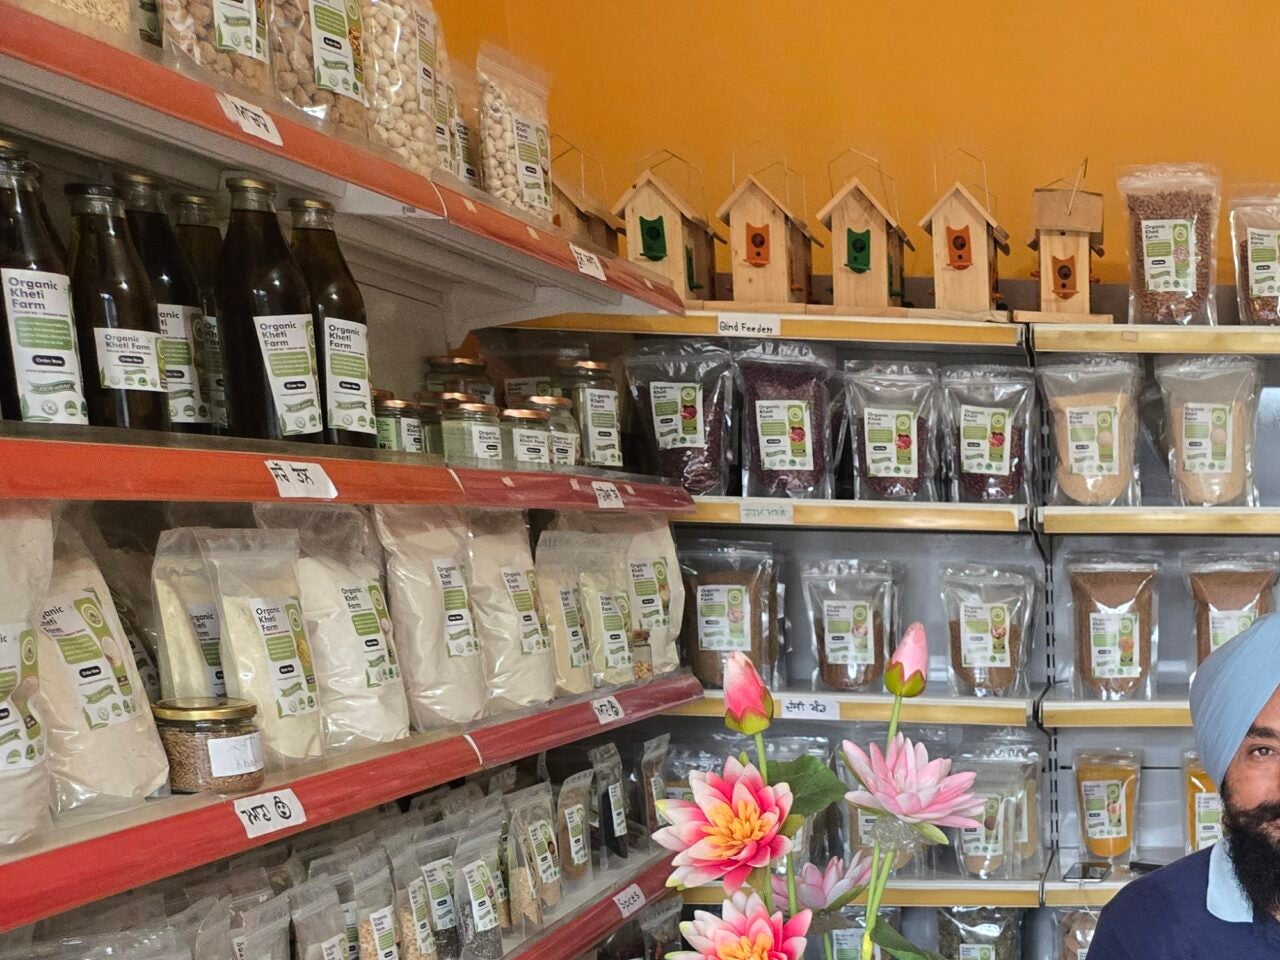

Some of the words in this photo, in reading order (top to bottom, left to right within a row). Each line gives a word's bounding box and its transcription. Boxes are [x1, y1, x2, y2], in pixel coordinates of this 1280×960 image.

[9, 277, 58, 291] Organic
[11, 288, 44, 300] Kheti
[13, 300, 46, 310] Farm
[260, 322, 297, 332] Organic
[328, 324, 359, 337] Organic
[105, 333, 139, 343] Organic
[262, 330, 288, 339] Kheti
[329, 332, 352, 342] Kheti
[106, 341, 130, 349] Kheti
[131, 343, 151, 351] Farm
[264, 339, 289, 347] Farm
[329, 340, 352, 350] Farm
[341, 587, 362, 596] Organic
[256, 606, 280, 616] Organic
[259, 615, 274, 624] Kheti
[261, 624, 279, 632] Farm
